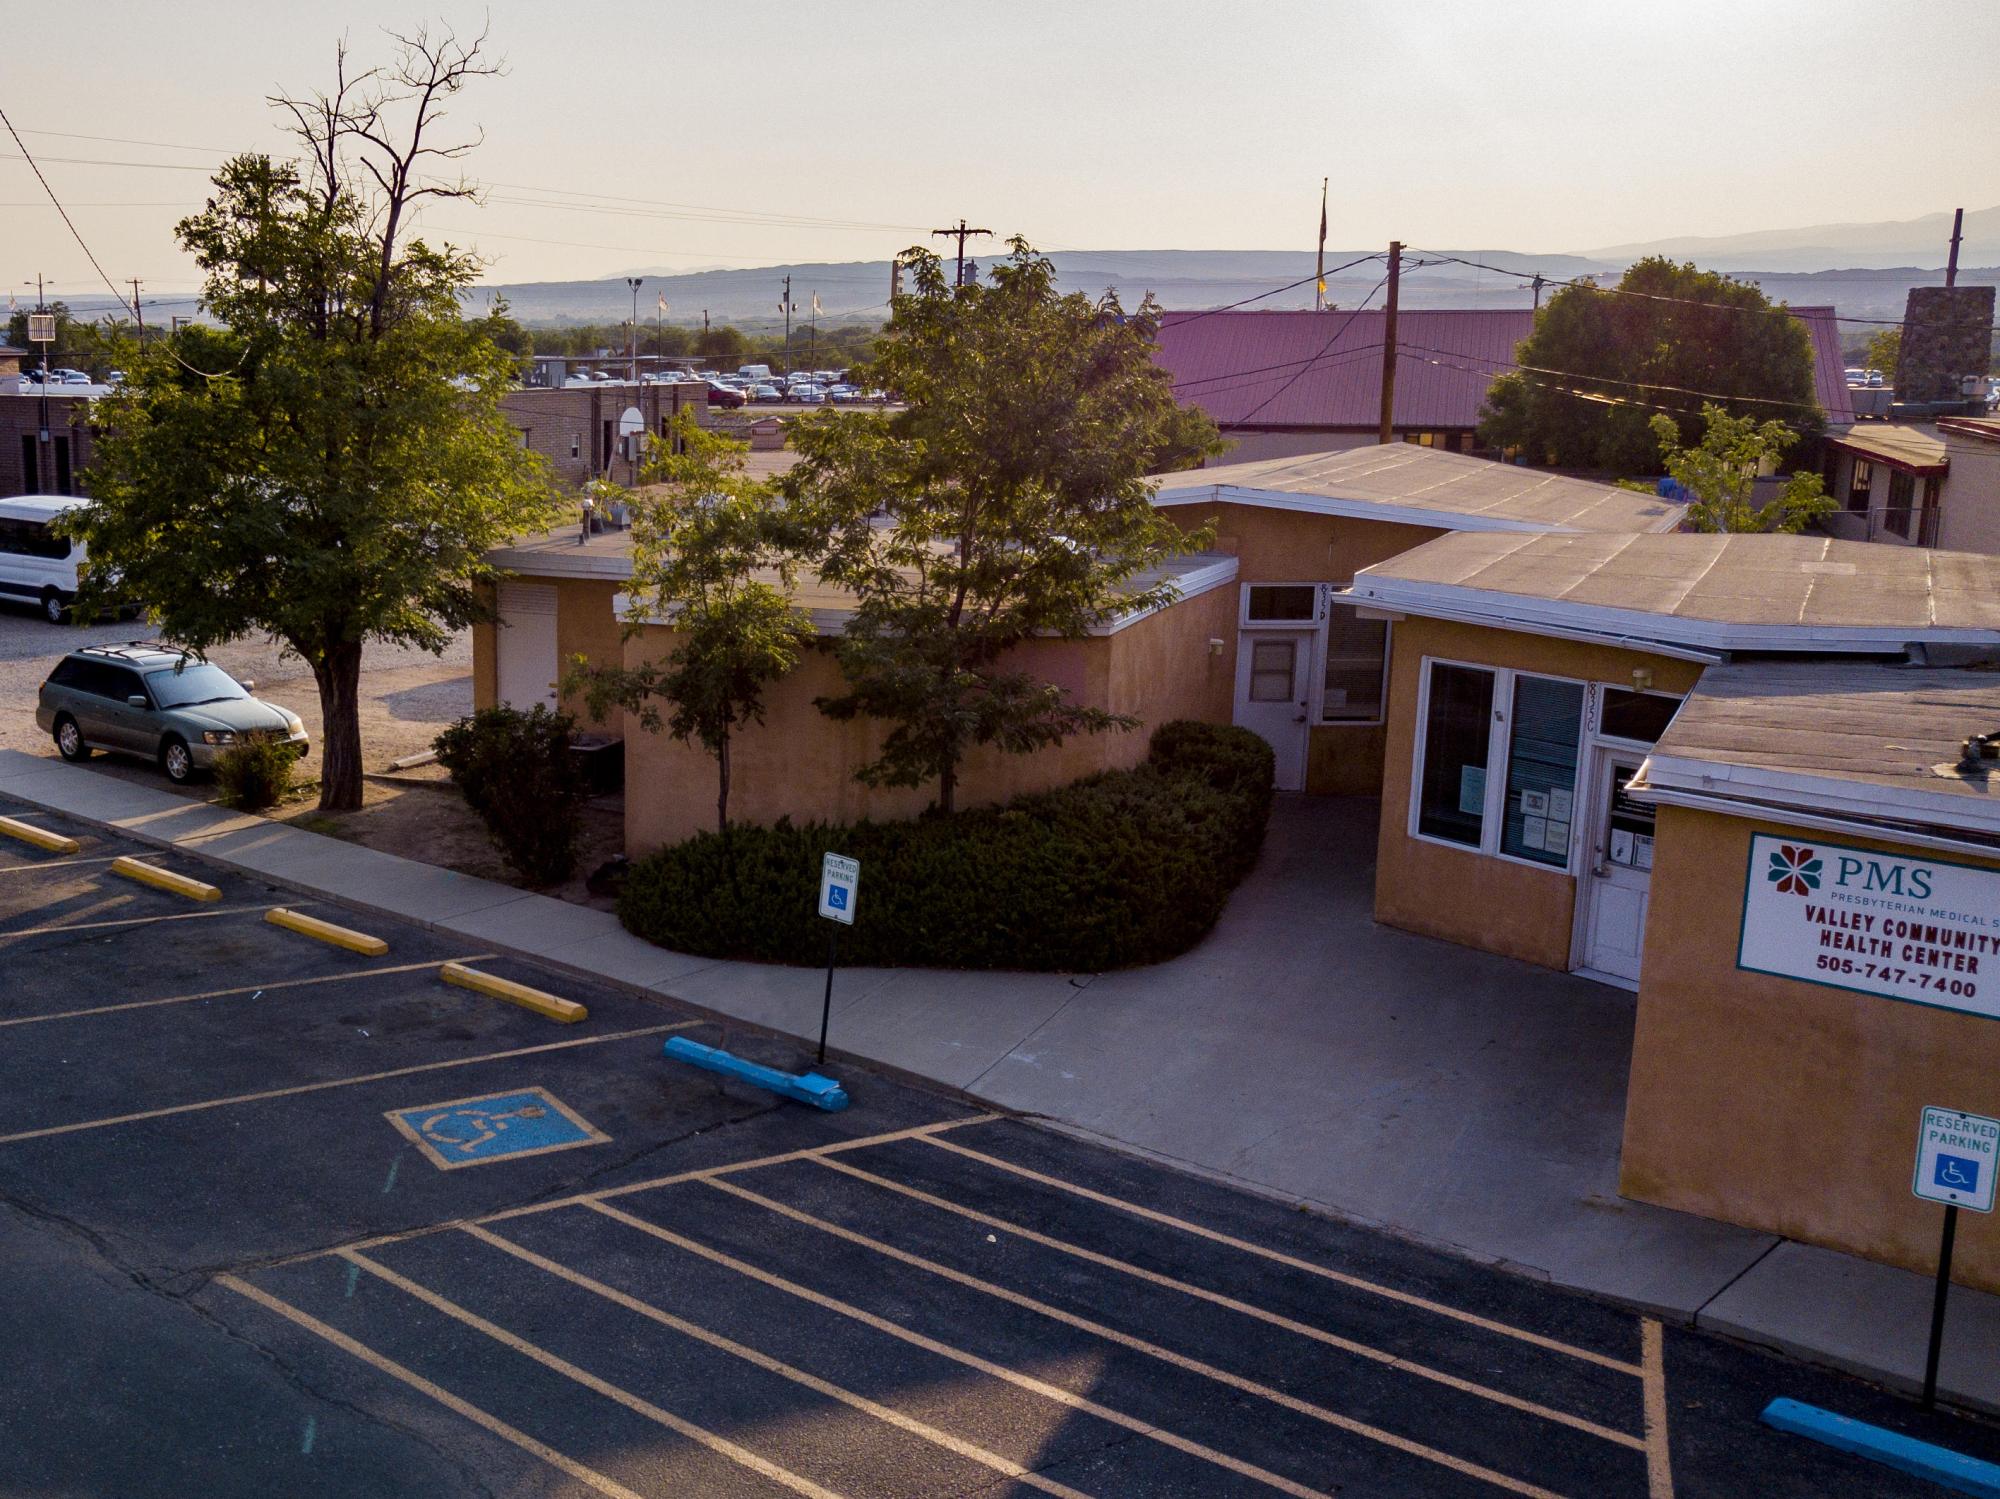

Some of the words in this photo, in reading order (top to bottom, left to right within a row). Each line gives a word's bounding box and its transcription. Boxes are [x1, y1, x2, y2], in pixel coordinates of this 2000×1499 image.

[826, 858, 857, 873] RESERVED
[827, 869, 854, 884] PARKING
[1835, 856, 1932, 900] PMS
[1831, 891, 1925, 915] PRESBYTERIAN
[1930, 909, 1987, 927] MEDICAL
[1805, 904, 1875, 933] VALLEY
[1883, 918, 2000, 956] COMMUNITY
[1820, 929, 1892, 959] HEALTH
[1902, 944, 1980, 975] CENTER
[1816, 954, 1976, 998] 505-747-7400
[1926, 1114, 1997, 1138] RESERVED
[1929, 1130, 1991, 1153] PARKING
